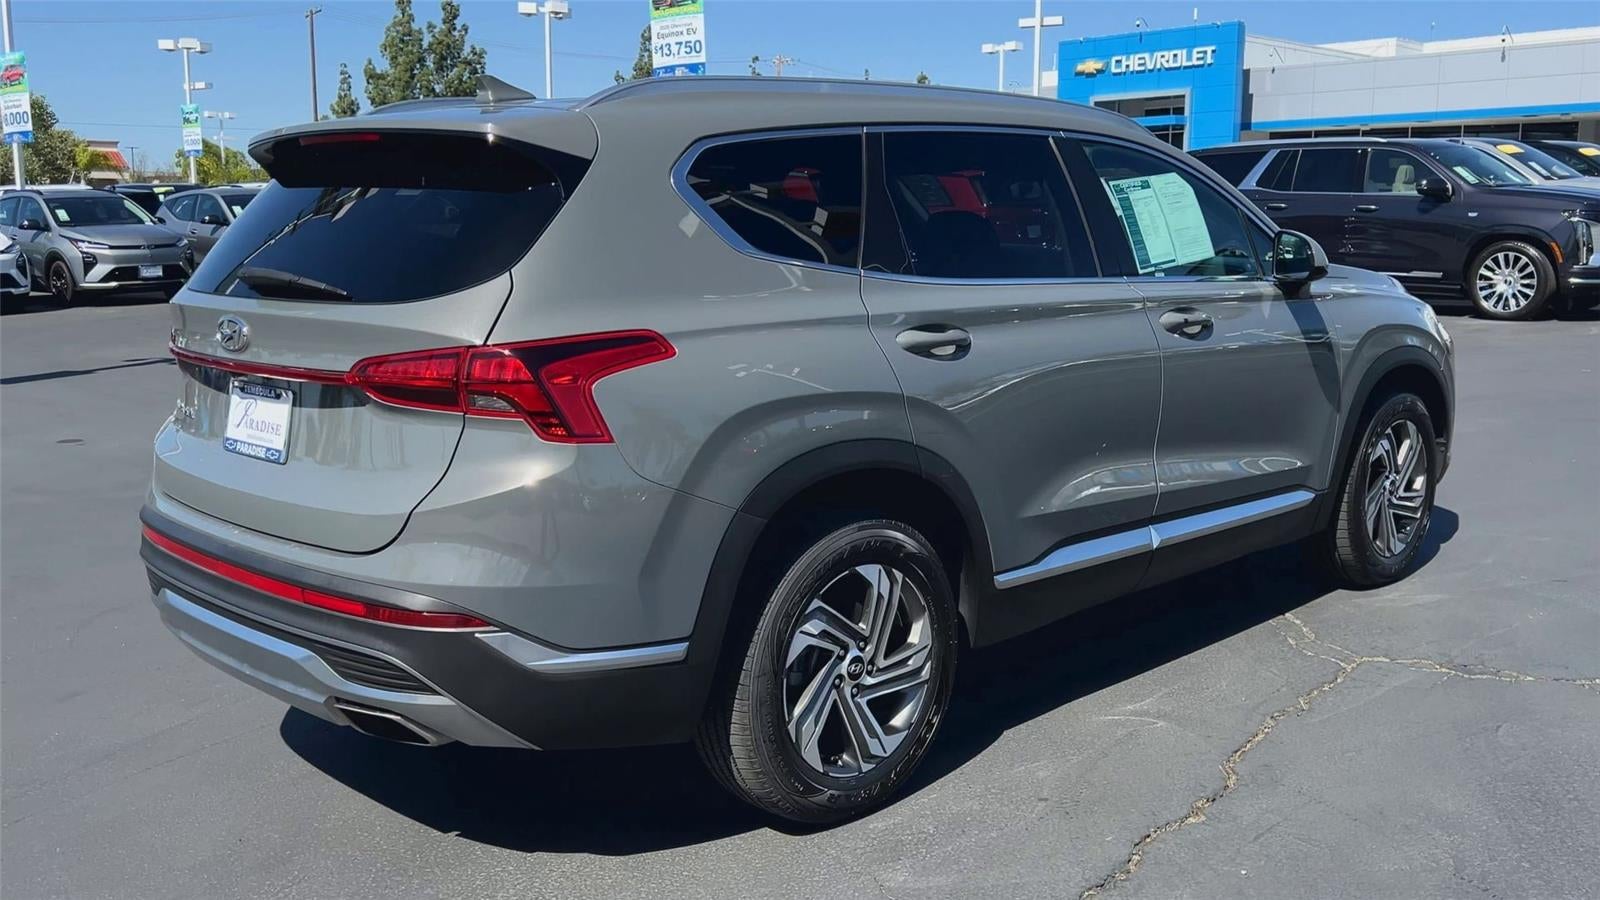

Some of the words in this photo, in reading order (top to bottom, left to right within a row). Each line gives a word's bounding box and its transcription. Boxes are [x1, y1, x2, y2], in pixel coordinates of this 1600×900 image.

[656, 29, 684, 40] Equinox
[686, 27, 697, 35] EV
[654, 40, 702, 58] $13,750
[1111, 45, 1216, 74] CHEVROLET
[244, 385, 276, 398] TEMECULA
[236, 442, 267, 458] PARADISE
